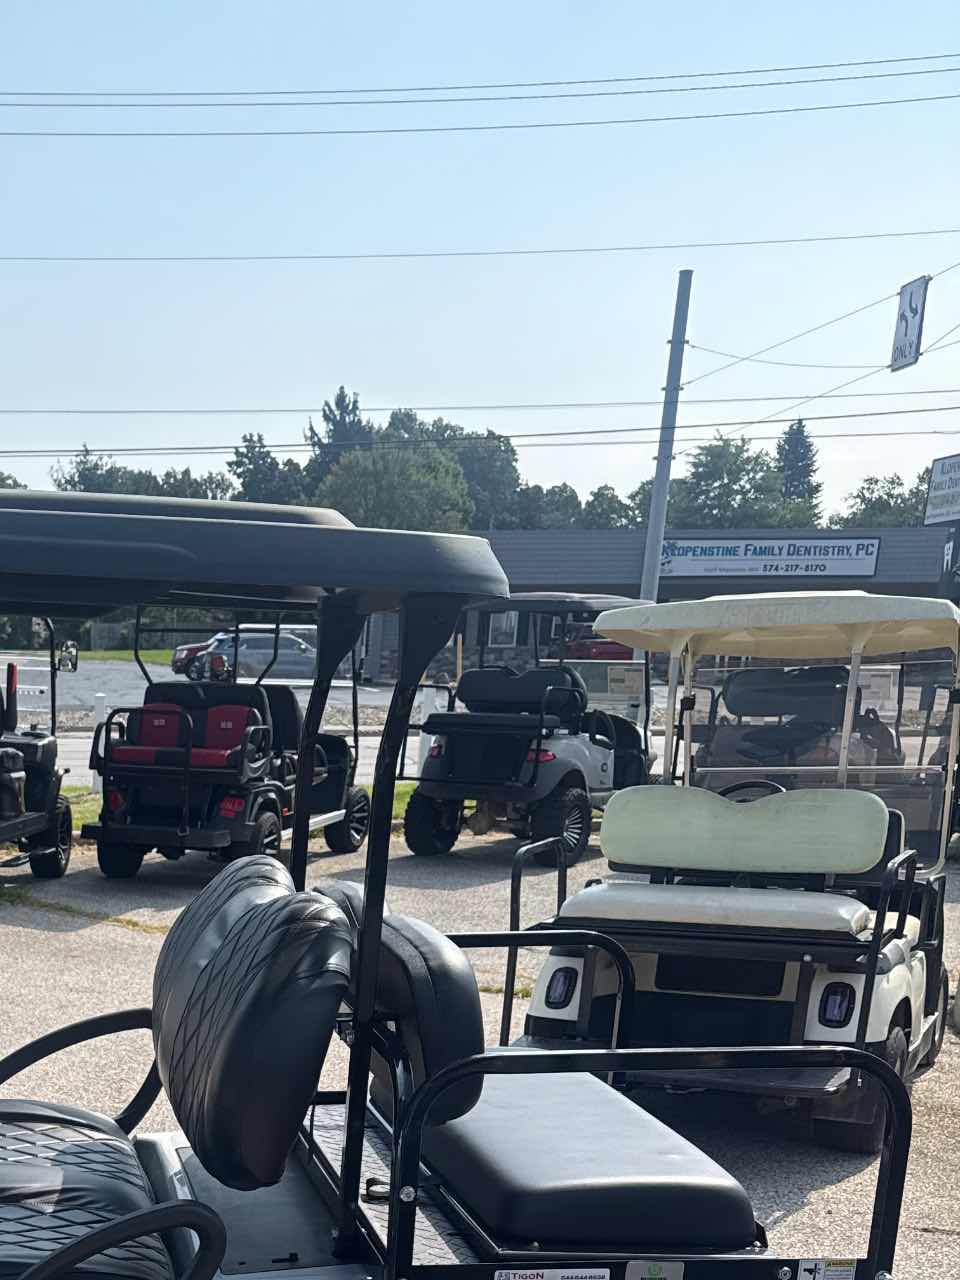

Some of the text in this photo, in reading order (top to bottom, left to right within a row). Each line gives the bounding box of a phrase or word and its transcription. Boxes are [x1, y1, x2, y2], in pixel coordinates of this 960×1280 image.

[893, 341, 916, 362] ONLY
[744, 543, 784, 557] FAMILY
[786, 543, 852, 557] DENTISTRY,
[856, 543, 875, 556] PC
